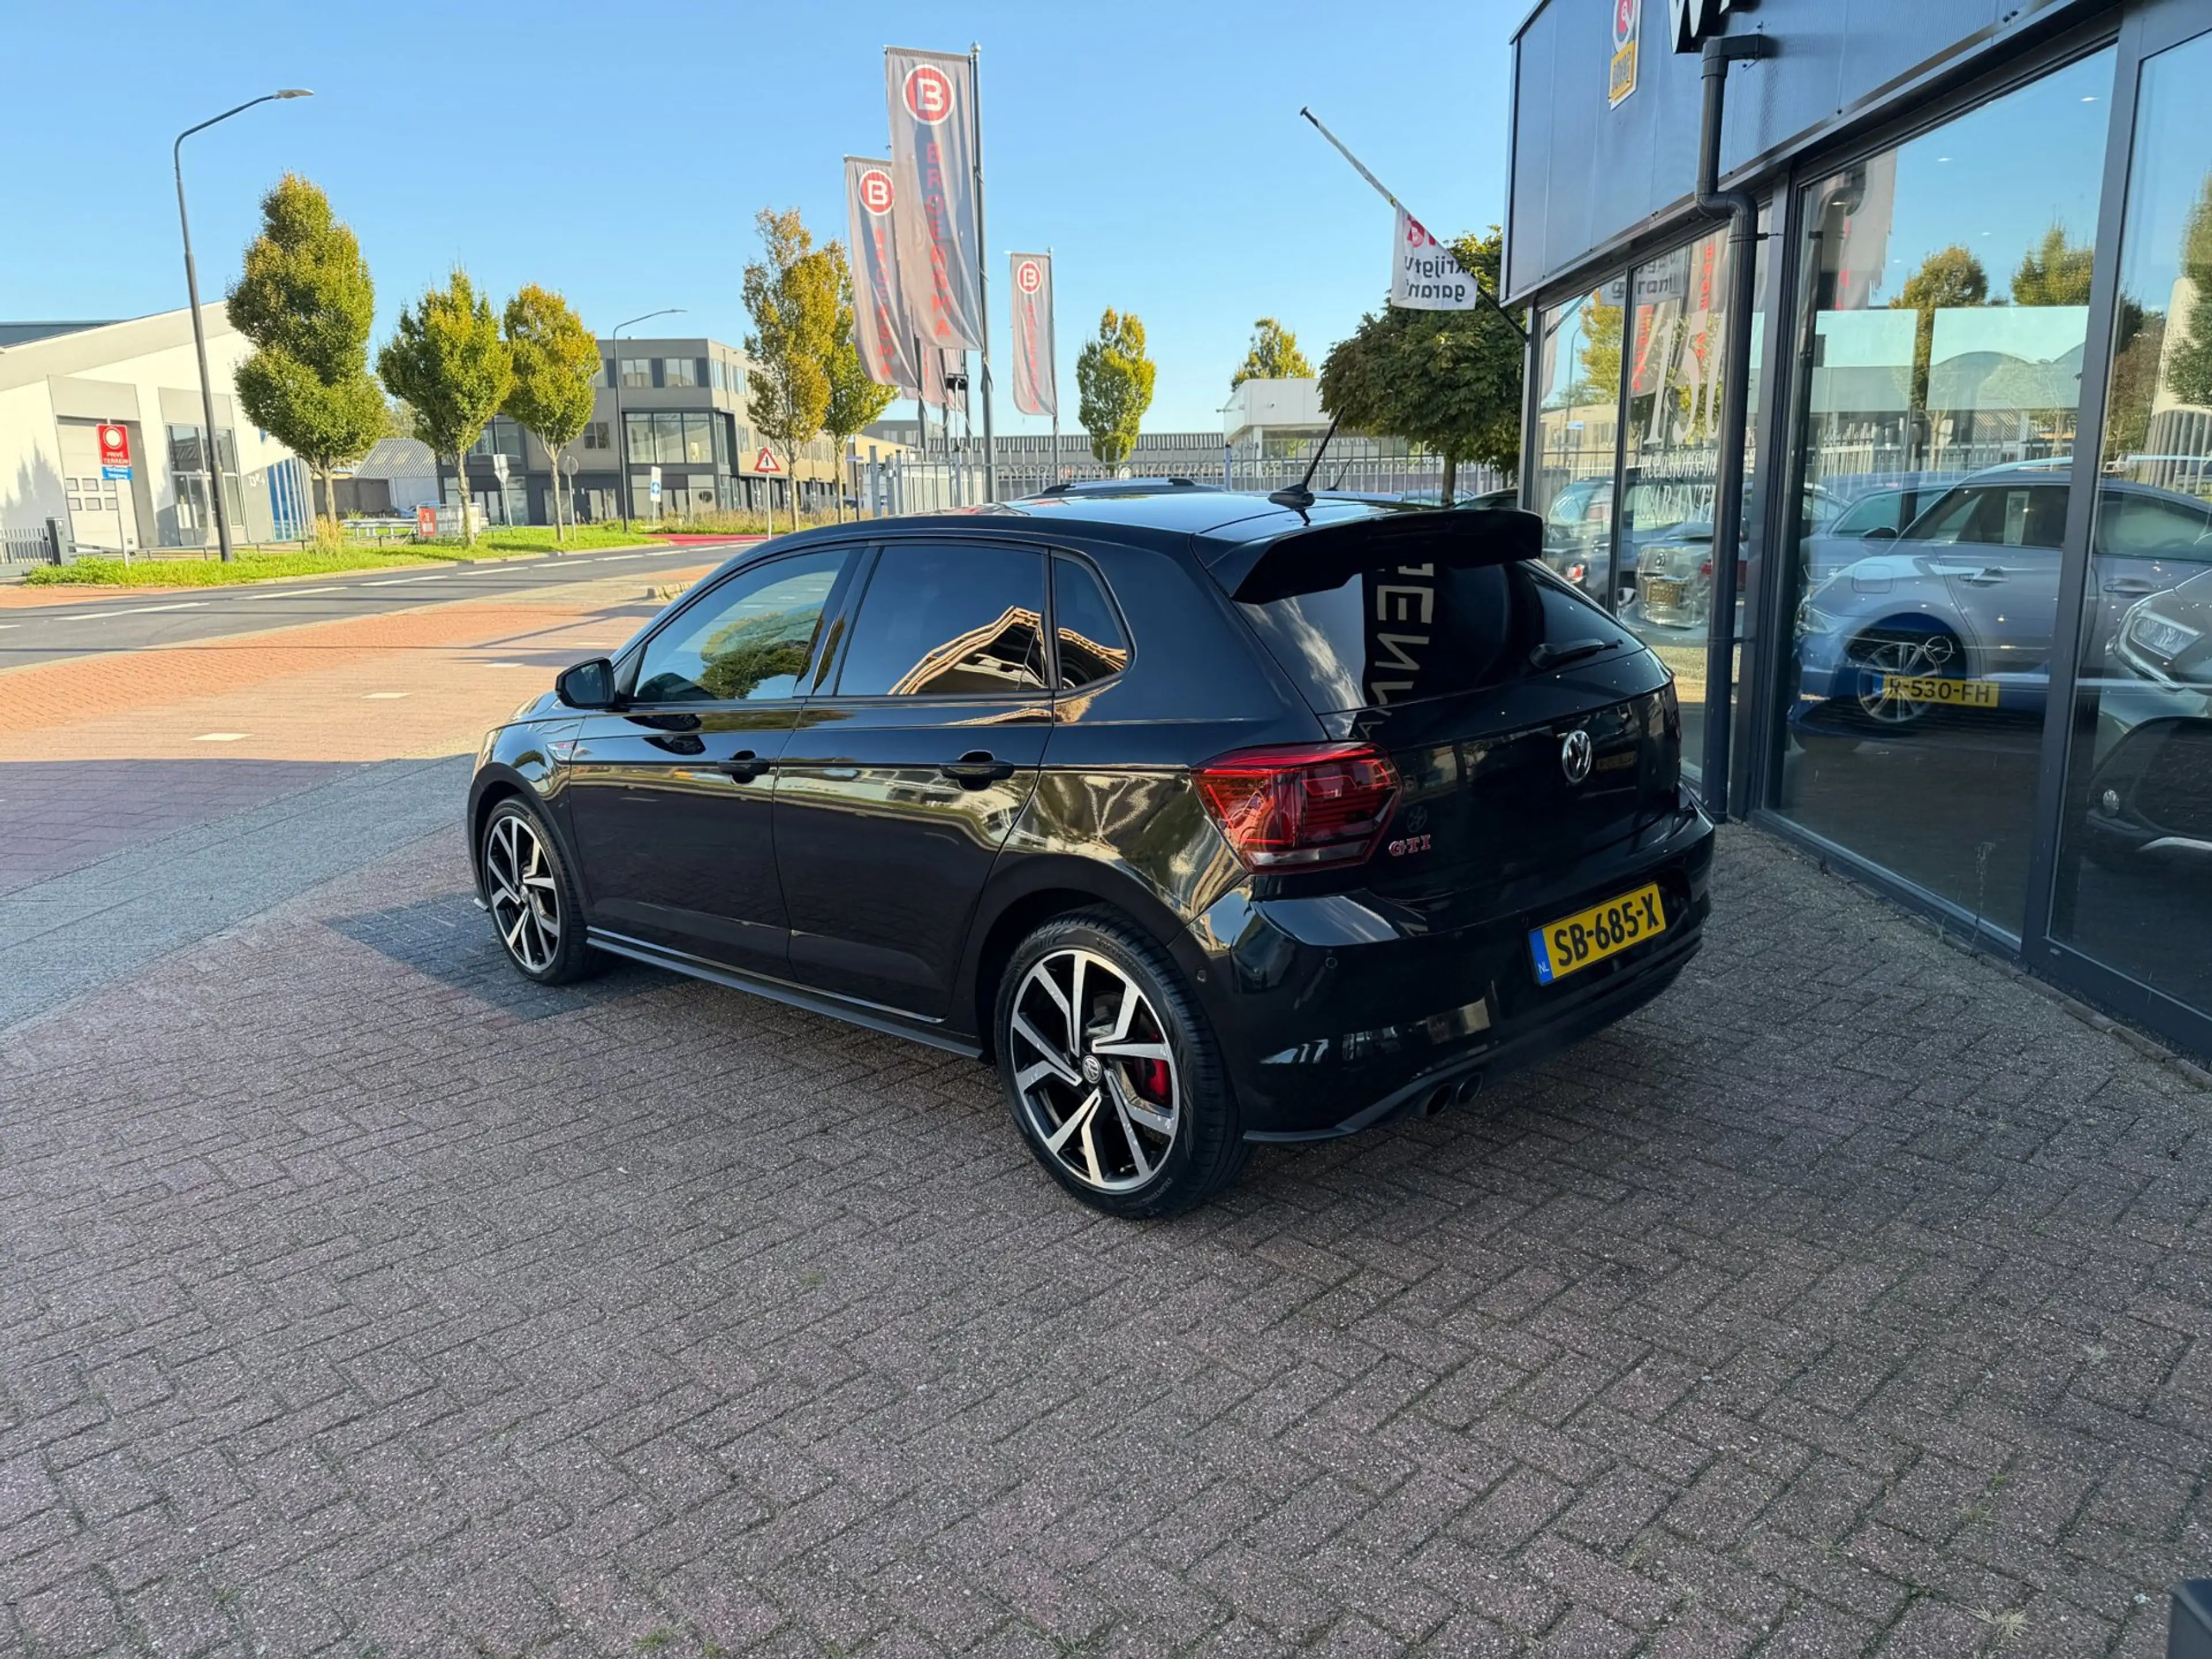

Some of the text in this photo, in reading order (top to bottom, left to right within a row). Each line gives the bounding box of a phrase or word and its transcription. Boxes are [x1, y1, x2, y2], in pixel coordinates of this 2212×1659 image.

[917, 77, 944, 111] B
[868, 180, 888, 205] B
[1388, 834, 1431, 857] GTI
[1554, 893, 1660, 967] SB-685-X
[1537, 962, 1550, 974] NL
